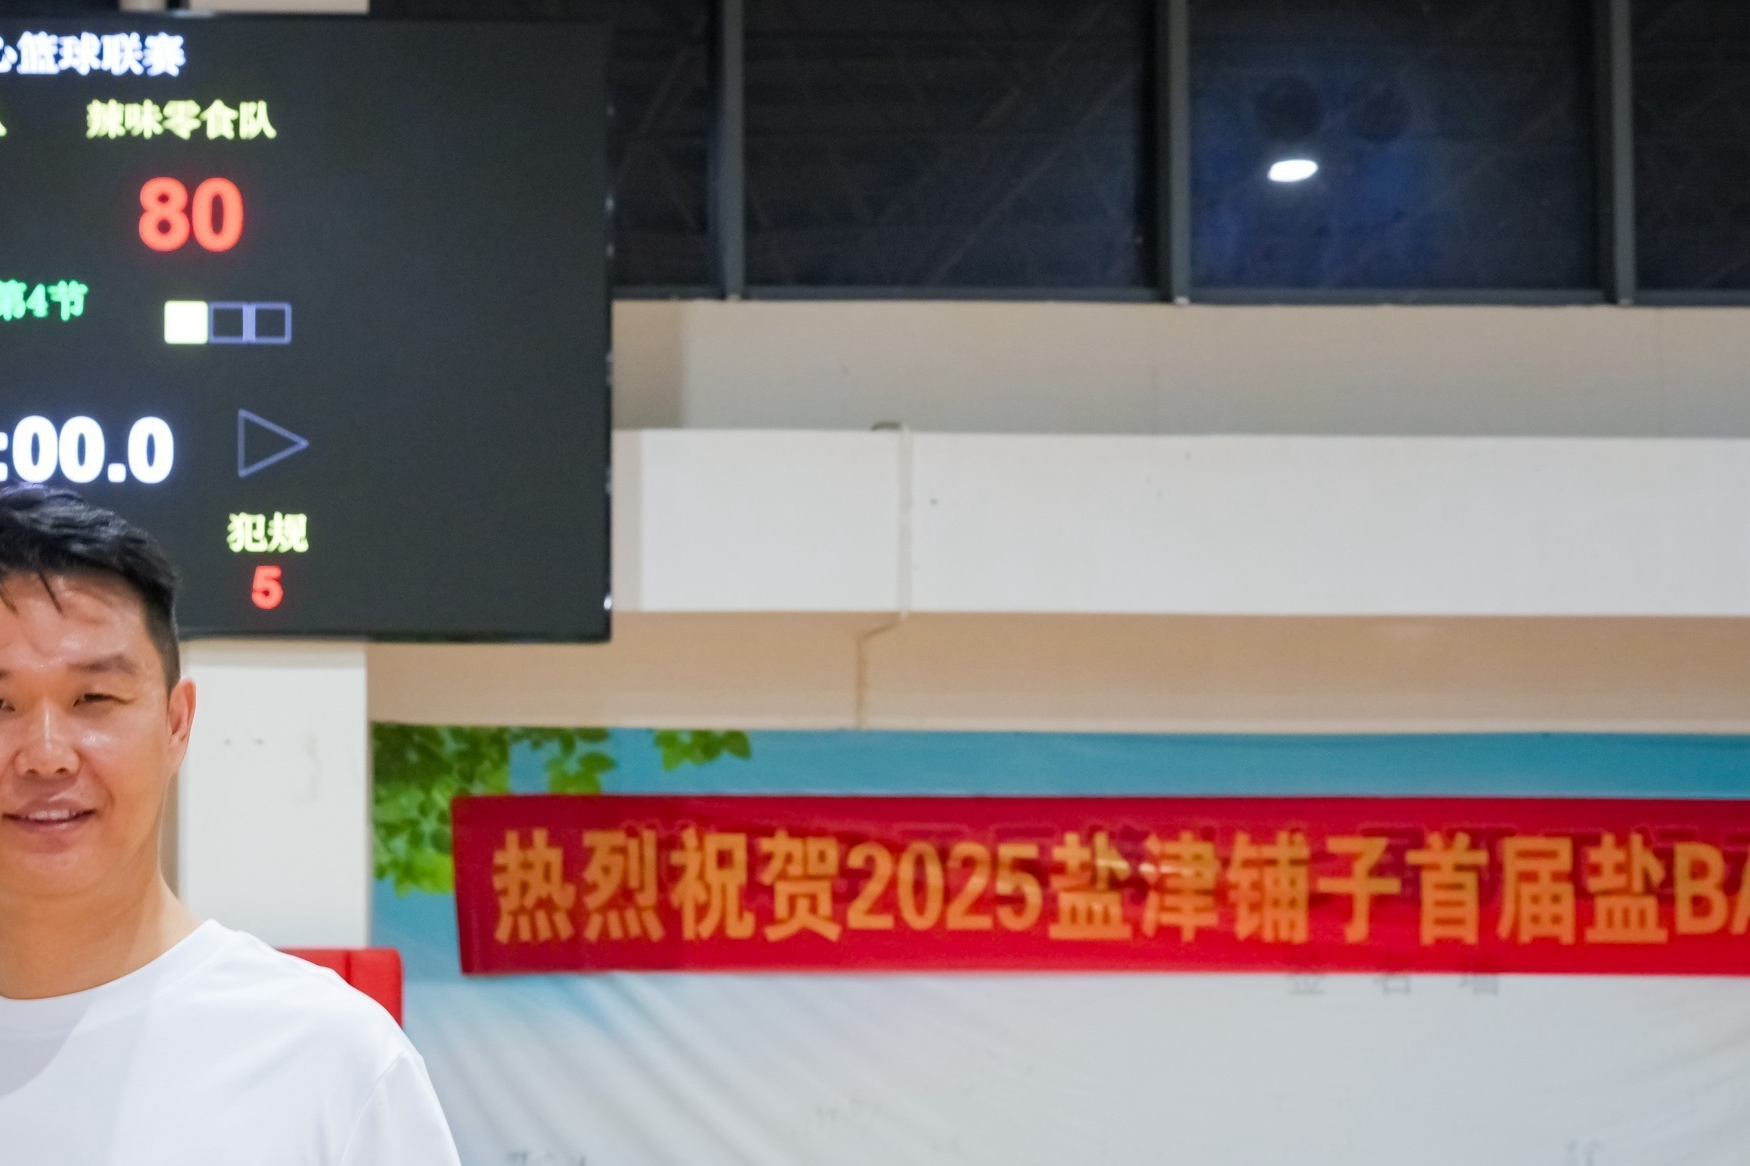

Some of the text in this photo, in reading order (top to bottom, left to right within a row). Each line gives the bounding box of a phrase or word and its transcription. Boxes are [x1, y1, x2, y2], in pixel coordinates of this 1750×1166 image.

[86, 99, 277, 140] 辣味零食队
[138, 177, 244, 252] 80
[226, 511, 310, 554] 犯规
[251, 565, 284, 609] 5
